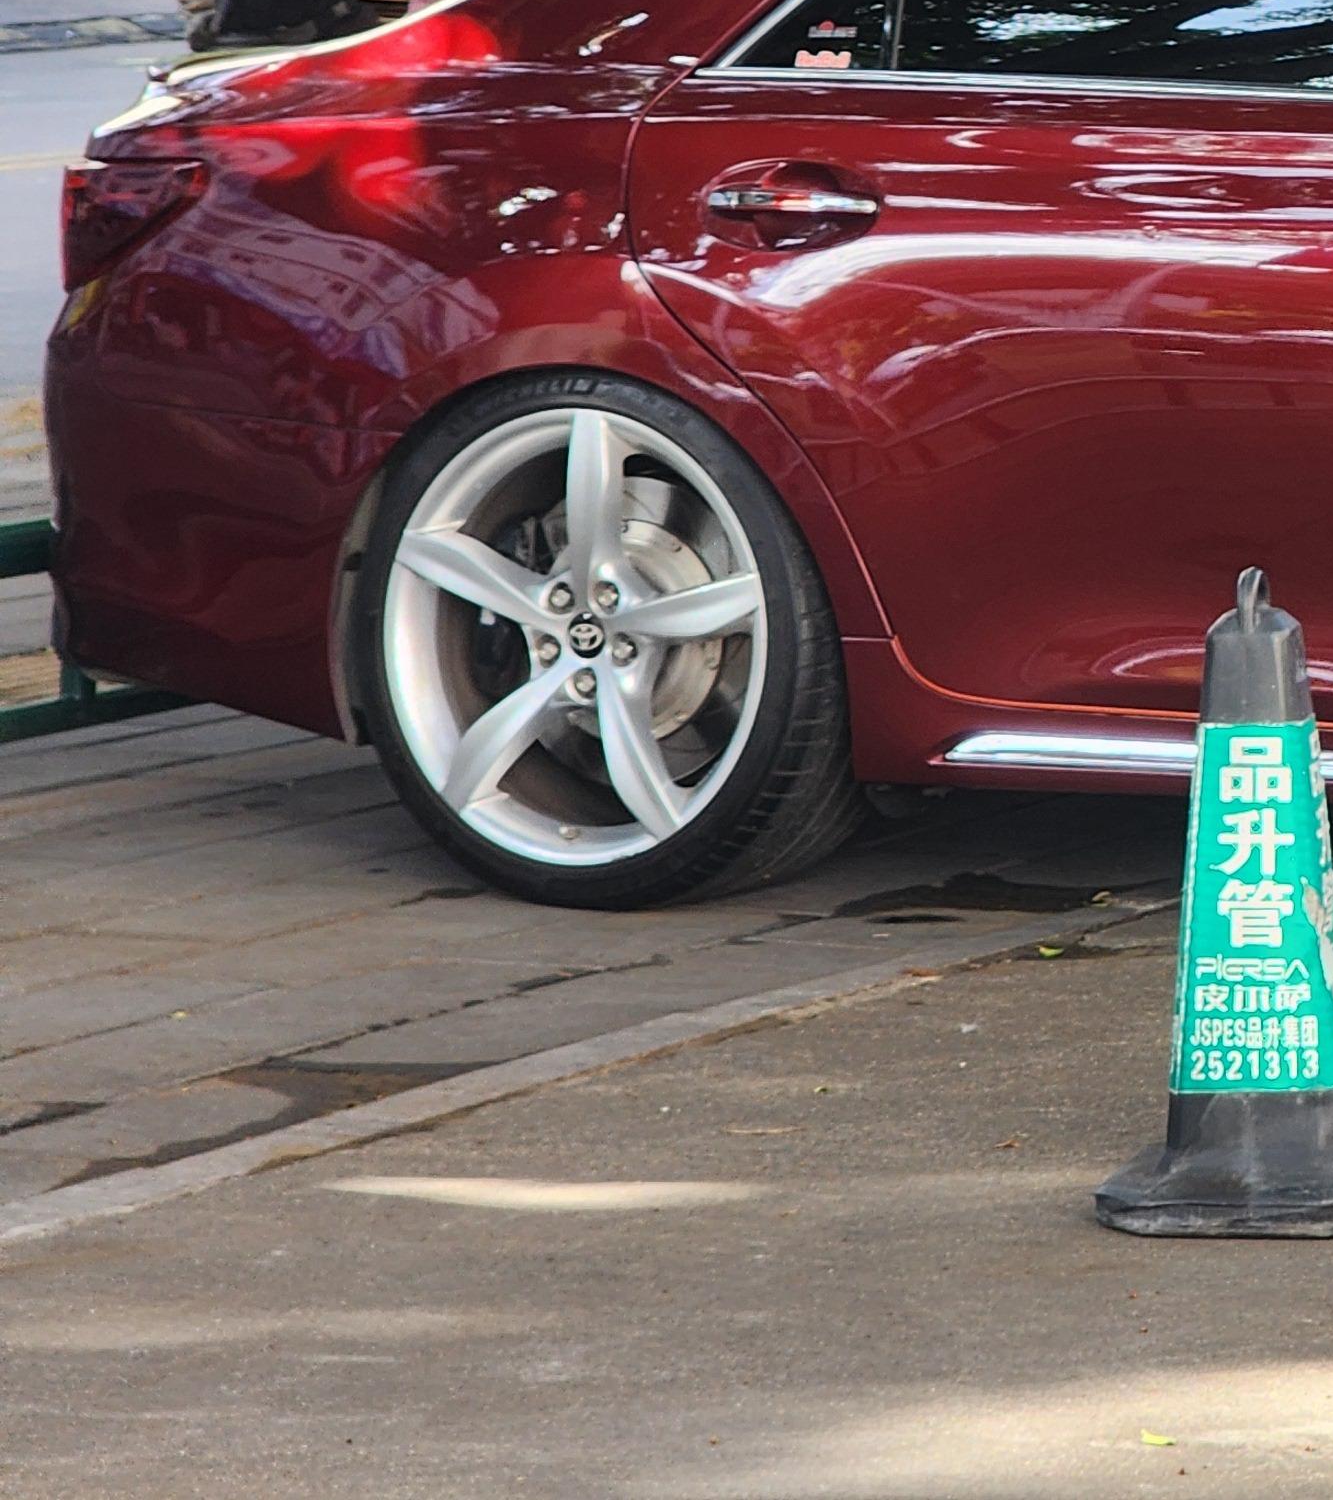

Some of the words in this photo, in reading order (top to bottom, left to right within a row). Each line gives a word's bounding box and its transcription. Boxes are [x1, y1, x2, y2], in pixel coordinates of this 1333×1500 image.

[1212, 736, 1295, 948] 品升管
[1194, 982, 1312, 1014] 皮尔萨
[1189, 1014, 1319, 1050] JSPES品升集团
[1190, 1049, 1319, 1082] 2521313
